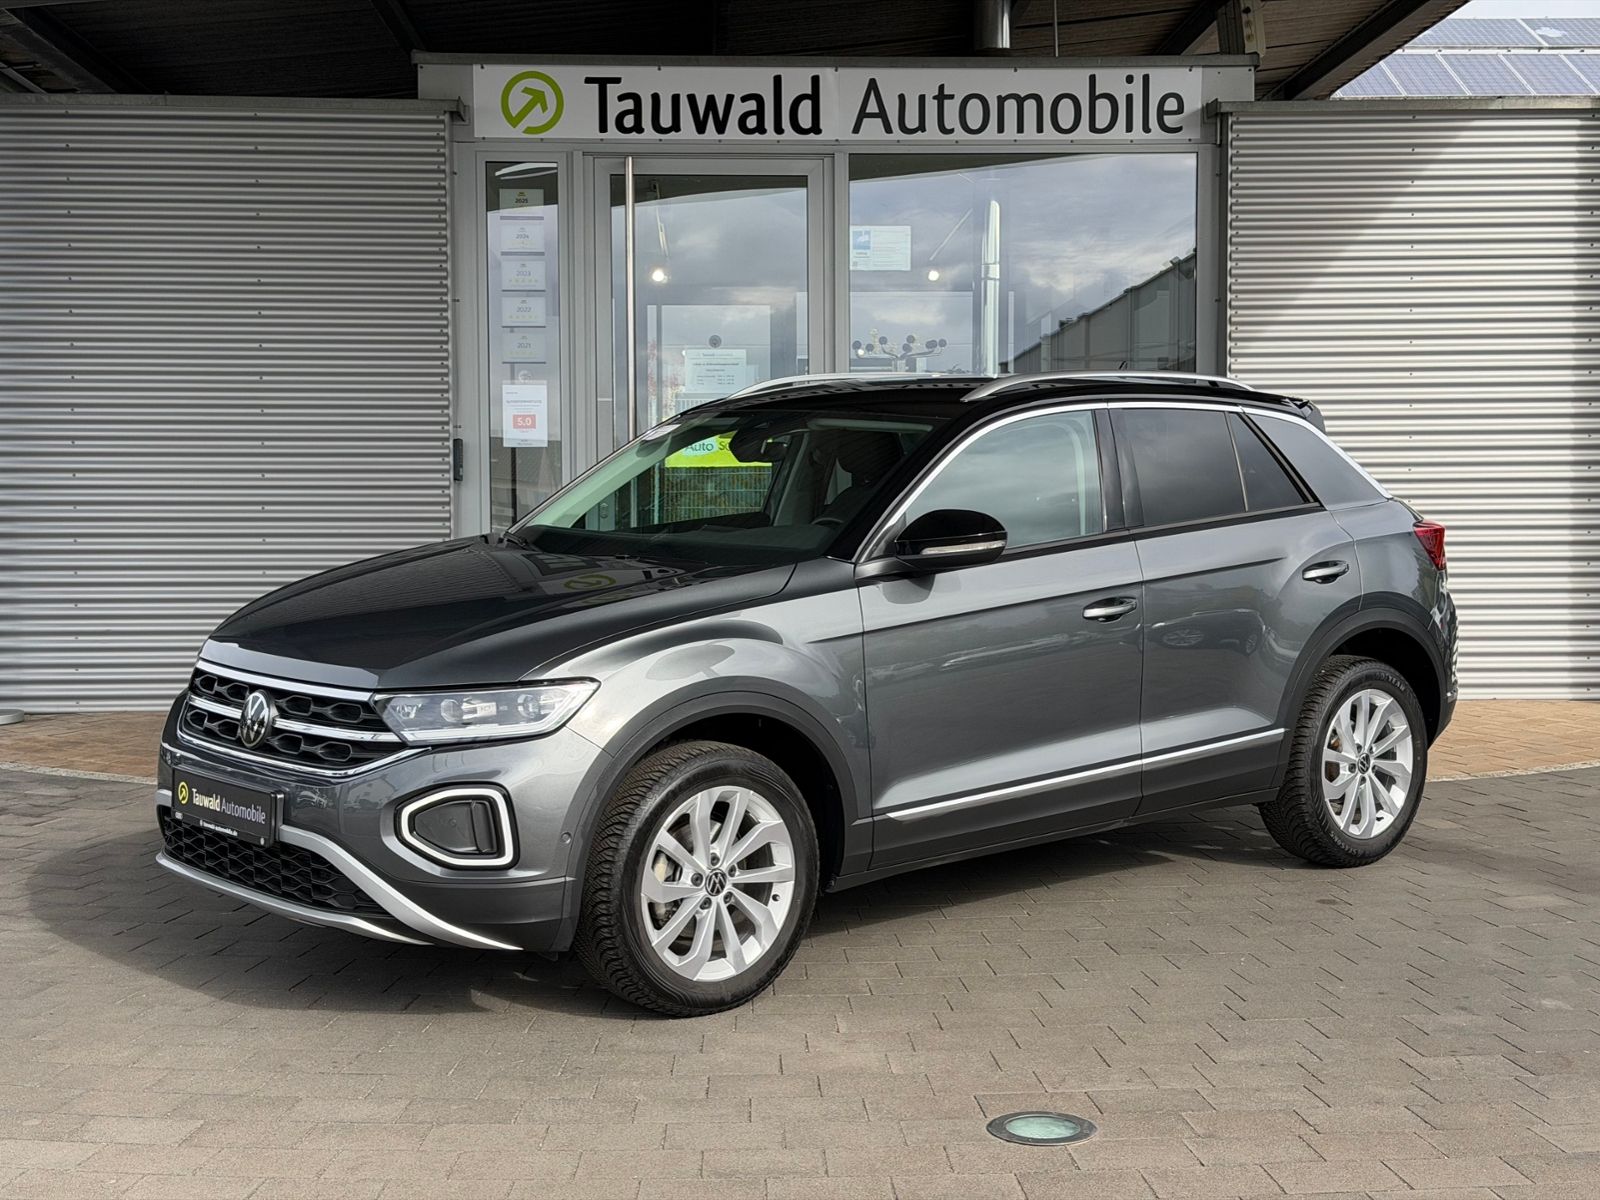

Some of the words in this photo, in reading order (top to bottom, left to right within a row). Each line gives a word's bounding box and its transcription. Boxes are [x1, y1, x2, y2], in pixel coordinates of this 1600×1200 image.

[584, 74, 822, 135] Tauwald
[851, 73, 1186, 135] Automobile
[517, 417, 532, 426] 5.0
[191, 788, 221, 811] Tauwald
[221, 797, 266, 825] Automobile
